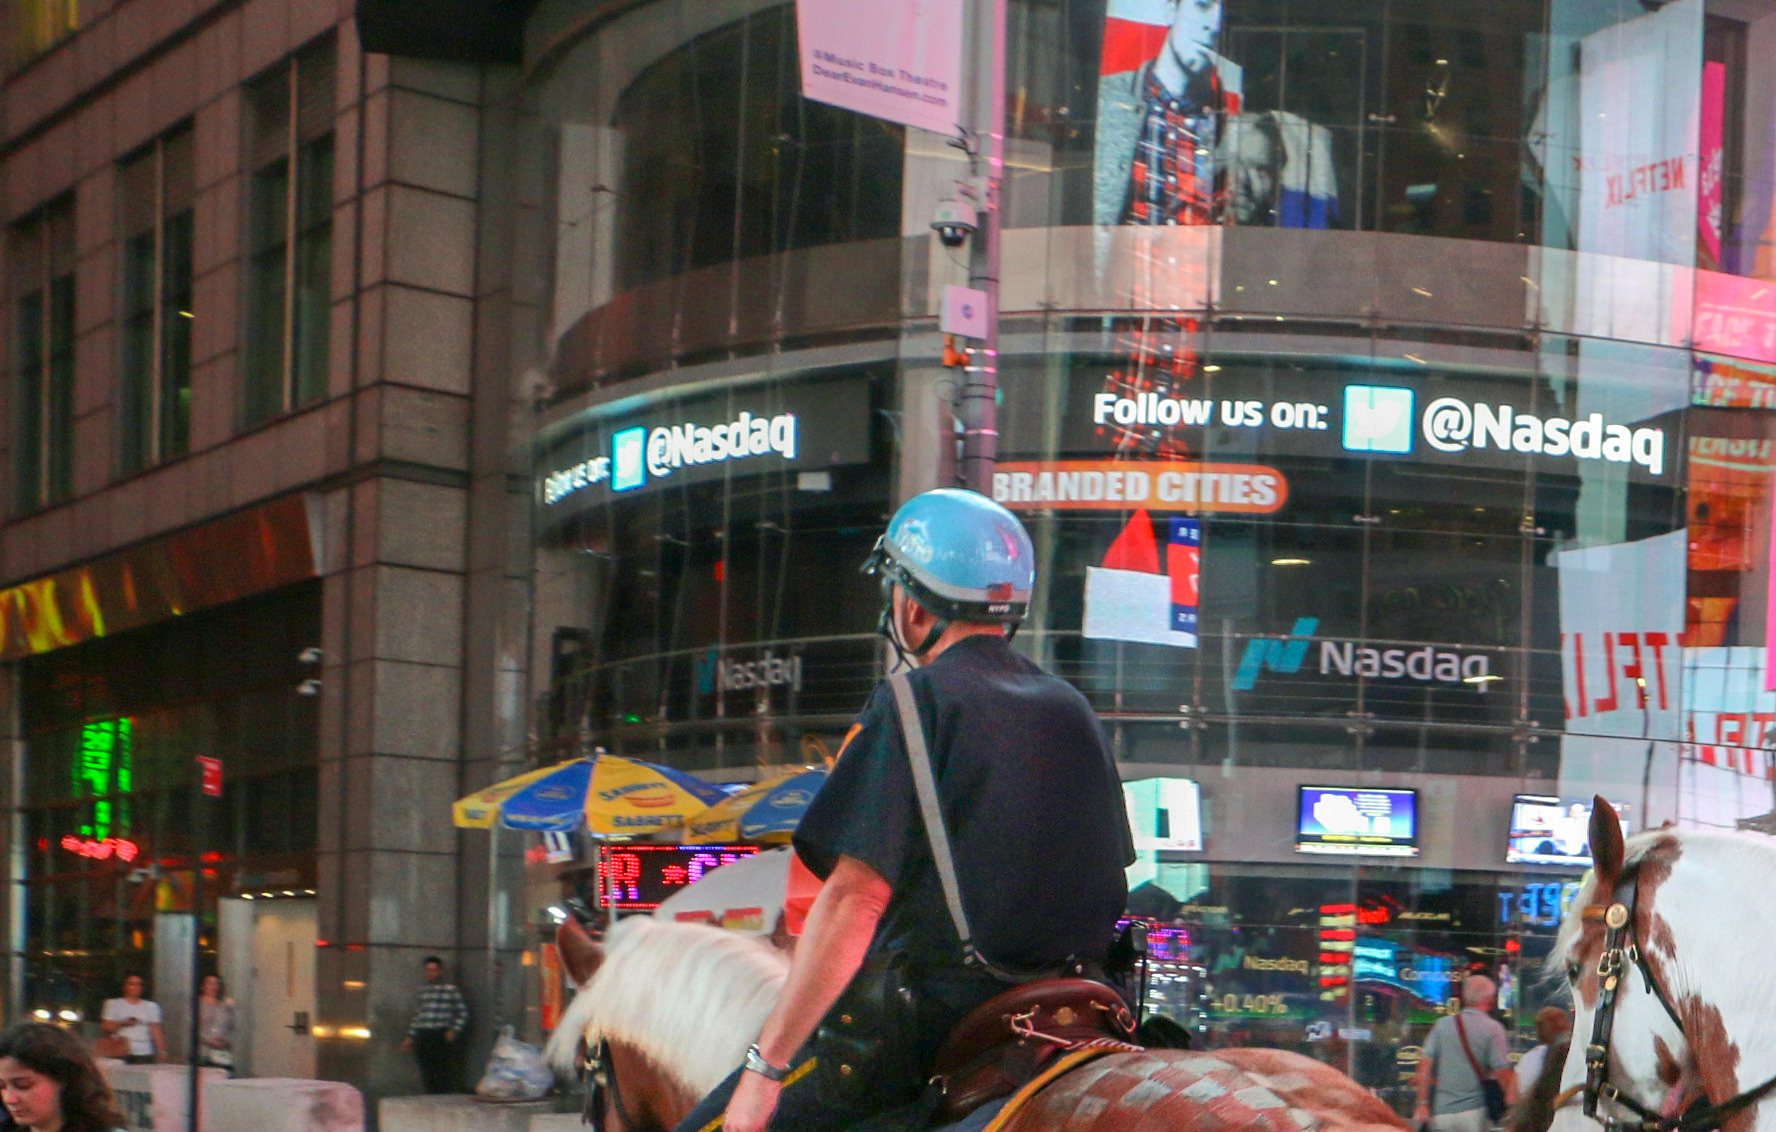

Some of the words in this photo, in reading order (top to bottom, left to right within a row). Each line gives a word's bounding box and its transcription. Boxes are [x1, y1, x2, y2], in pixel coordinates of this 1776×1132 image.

[647, 411, 798, 478] @Nasdaq
[1093, 393, 1213, 428] Follow
[1219, 400, 1264, 428] us
[1270, 402, 1328, 431] on:
[1422, 397, 1664, 475] @Nasdaq
[992, 471, 1151, 502] BRANDED
[1157, 472, 1277, 506] CITIES
[717, 651, 802, 692] Nasdaq
[1319, 640, 1489, 692] Nasdaq
[1243, 955, 1309, 975] Nasdaq
[1210, 993, 1289, 1014] +0.40%
